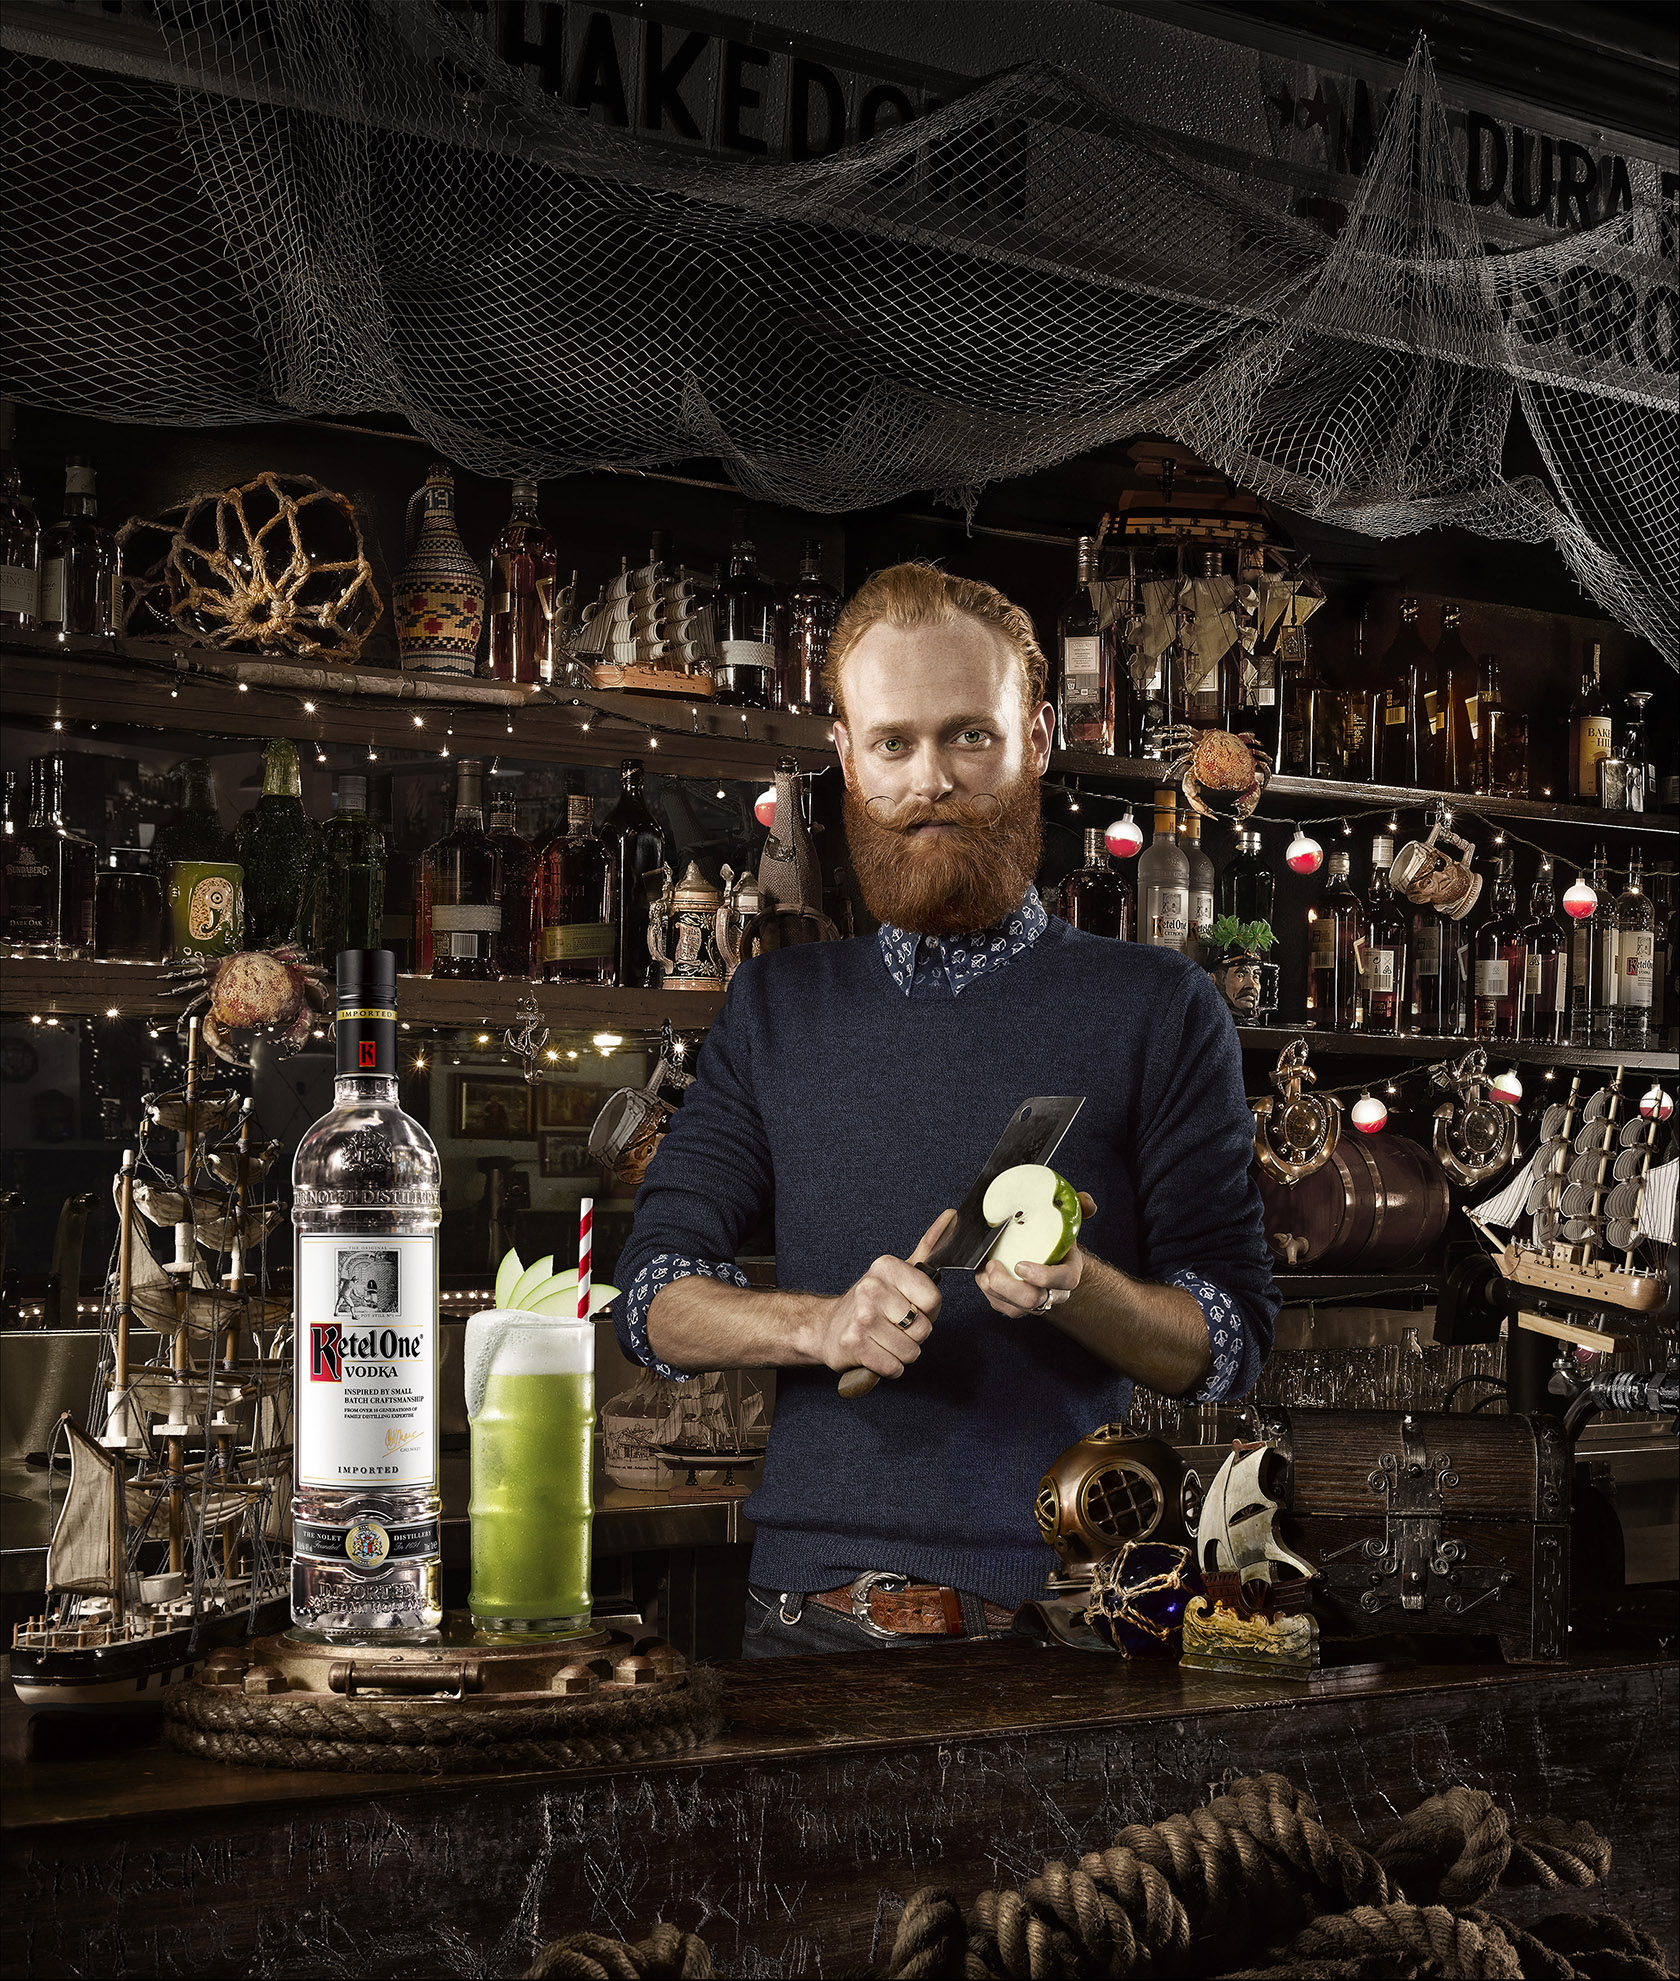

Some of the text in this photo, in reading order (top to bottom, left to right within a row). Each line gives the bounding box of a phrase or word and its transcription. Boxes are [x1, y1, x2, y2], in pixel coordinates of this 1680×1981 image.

[341, 1010, 393, 1019] IMPORTED
[361, 1043, 375, 1066] K
[344, 1366, 399, 1379] VODKA
[344, 1387, 413, 1396] INSPIRED BY SMALL
[369, 1395, 425, 1405] CRAFTSMANSHIP
[338, 1465, 399, 1474] IMPORTED
[303, 1530, 343, 1542] THE NOLET
[393, 1530, 432, 1541] DISTILLERY
[318, 1582, 416, 1600] IMPORTED
